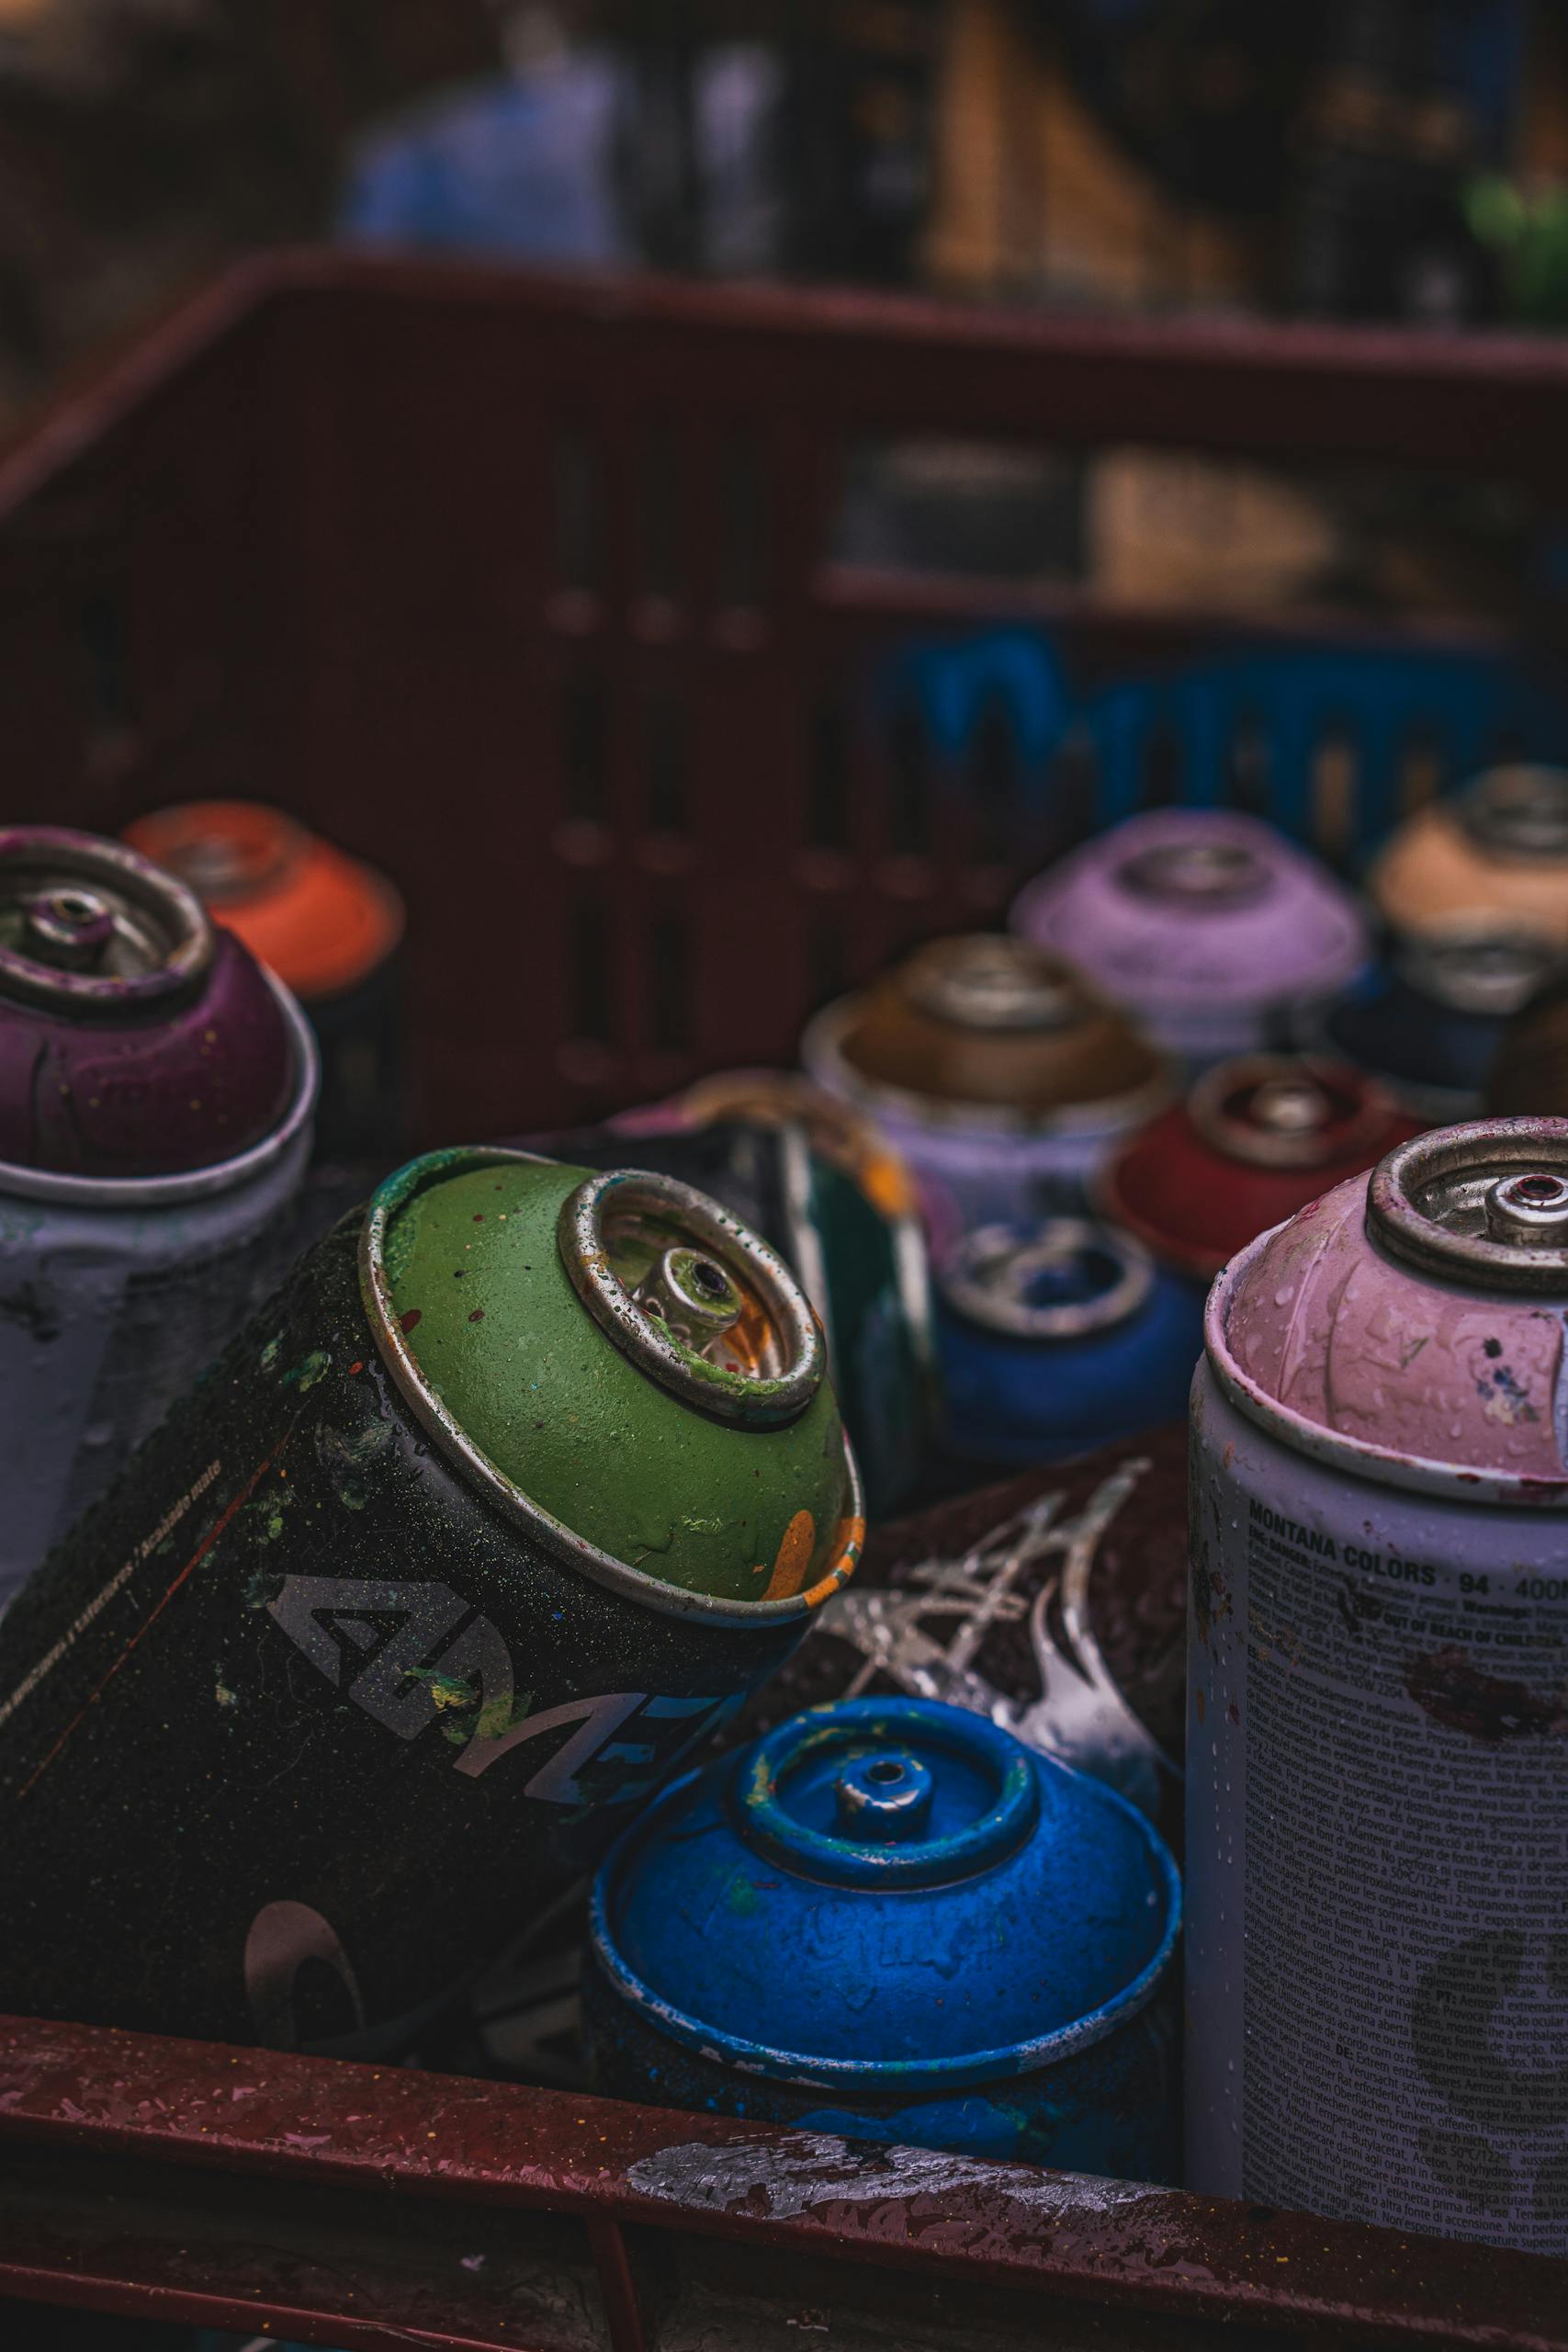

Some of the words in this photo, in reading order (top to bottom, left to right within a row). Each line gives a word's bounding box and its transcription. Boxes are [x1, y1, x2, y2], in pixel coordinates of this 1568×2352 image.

[1249, 1497, 1336, 1560] MONTANA
[1345, 1544, 1435, 1588] COLORS
[1459, 1571, 1488, 1595] 94
[1383, 1611, 1407, 1630] OUT
[1411, 1619, 1427, 1634] OF
[1430, 1623, 1472, 1642] REACH
[1475, 1630, 1490, 1644] OF
[1332, 1734, 1374, 1758] cualquier
[1376, 1749, 1396, 1764] otra
[1398, 1752, 1431, 1772] fuente
[1339, 1723, 1371, 1743] envase
[1440, 1747, 1492, 1767] Mantener
[1360, 1715, 1389, 1734] ocular
[1426, 1730, 1468, 1749] Provoca
[1334, 1748, 1378, 1774] exteriores
[1424, 1773, 1450, 1792] lugar
[1453, 1779, 1477, 1794] bien
[1347, 1769, 1408, 1796] conformidad
[1410, 1787, 1429, 1801] con
[1443, 1793, 1497, 1811] normativa
[1303, 1778, 1339, 1804] provocar
[1343, 1792, 1371, 1816] danys
[1342, 1778, 1393, 1806] Importado
[1404, 1797, 1459, 1820] distribuido
[1476, 1811, 1530, 1828] Argentina
[1533, 1818, 1551, 1831] por
[1339, 1805, 1354, 1823] Pot
[1357, 1815, 1398, 1837] provocar
[1402, 1827, 1421, 1842] una
[1425, 1833, 1461, 1849] reacció
[1348, 1823, 1393, 1849] Mantenir
[1394, 1839, 1435, 1860] allunyat
[1451, 1849, 1478, 1866] fonts
[1280, 1821, 1333, 1858] temperatures
[1336, 1849, 1379, 1874] superiors
[1457, 1880, 1500, 1897] Eliminar
[1315, 1824, 1334, 1844] font
[1398, 1855, 1438, 1874] perforar
[1497, 1871, 1517, 1884] fins
[1308, 1865, 1336, 1887] graves
[1339, 1879, 1360, 1896] pour
[1379, 1893, 1418, 1913] organes
[1443, 1907, 1469, 1922] suite
[1334, 1862, 1449, 1905] polihidroxialquilamides
[1293, 1885, 1319, 1908] portée
[1321, 1896, 1337, 1916] des
[1338, 1906, 1376, 1929] enfants.
[1380, 1918, 1397, 1936] Lire
[1329, 1889, 1375, 1916] provoquer
[1378, 1906, 1438, 1931] somnolence
[1300, 1917, 1330, 1940] endroit
[1334, 1930, 1353, 1950] bien
[1416, 1959, 1433, 1973] pas
[1437, 1963, 1477, 1980] respirer
[1481, 1968, 1495, 1982] les
[1313, 1938, 1379, 1973] conformément
[1416, 1972, 1496, 1996] réglementation
[1505, 1984, 1539, 1998] locale.
[1382, 1936, 1399, 1951] pas
[1402, 1941, 1448, 1961] vaporiser
[1450, 1951, 1466, 1964] sur
[1470, 1954, 1489, 1967] une
[1492, 1955, 1534, 1970] flamme
[1278, 1946, 1323, 1980] prolongada
[1337, 1976, 1375, 1999] repetida
[1378, 1991, 1393, 2006] por
[1443, 2004, 1484, 2022] Provoca
[1486, 2010, 1529, 2029] irritação
[1295, 1970, 1337, 2000] necessário
[1340, 1991, 1383, 2016] consultar
[1404, 2011, 1443, 2032] médico,
[1446, 2021, 1505, 2039] mostre-lhe
[1437, 1988, 1456, 2005] PT:
[1460, 1993, 1503, 2010] Aerossol
[1306, 2004, 1336, 2027] apenas
[1361, 2024, 1382, 2043] livre
[1416, 2040, 1444, 2058] locais
[1446, 2046, 1470, 2063] bem
[1344, 2006, 1375, 2027] chama
[1378, 2018, 1409, 2037] aberta
[1420, 2030, 1452, 2046] outras
[1454, 2034, 1486, 2051] fontes
[1336, 2041, 1353, 2061] DE:
[1356, 2050, 1390, 2073] Extrem
[1393, 2064, 1461, 2089] entzündbares
[1510, 2082, 1553, 2097] Behälter
[1337, 2031, 1369, 2052] acordo
[1371, 2043, 1391, 2060] com
[1406, 2054, 1477, 2077] regulamentos
[1514, 2069, 1555, 2083] Contém
[1348, 2061, 1398, 2089] Verursacht
[1402, 2081, 1444, 2100] schwere
[1293, 2075, 1349, 2115] durchstechen
[1351, 2105, 1372, 2123] oder
[1435, 2130, 1461, 2144] auch
[1462, 2133, 1489, 2148] nicht
[1492, 2138, 1517, 2151] nach
[1303, 2067, 1332, 2094] heißen
[1396, 2104, 1435, 2128] Funken,
[1437, 2115, 1477, 2133] offenen
[1481, 2121, 1530, 2138] Flammen
[1534, 2126, 1565, 2138] sowie
[1337, 2070, 1352, 2088] Rat
[1354, 2079, 1411, 2109] erforderlich,
[1415, 2095, 1474, 2122] Verpackung
[1477, 2108, 1501, 2121] oder
[1292, 2091, 1311, 2111] nicht
[1314, 2100, 1377, 2138] Temperaturen
[1380, 2129, 1398, 2144] von
[1402, 2135, 1428, 2152] mehr
[1432, 2142, 1447, 2155] als
[1294, 2120, 1334, 2149] provocare
[1336, 2138, 1361, 2160] danni
[1364, 2151, 1382, 2168] agli
[1384, 2158, 1416, 2177] organi
[1469, 2177, 1529, 2192] esposizione
[1342, 2156, 1388, 2183] provocare
[1390, 2174, 1409, 2188] una
[1411, 2179, 1454, 2198] reazione
[1456, 2187, 1499, 2206] allergica
[1413, 2150, 1451, 2172] Aceton,
[1308, 2165, 1342, 2193] fiamma
[1380, 2197, 1402, 2213] altra
[1404, 2201, 1431, 2221] fonte
[1507, 2220, 1529, 2233] Non
[1326, 2190, 1350, 2212] raggi
[1382, 2209, 1402, 2227] Non
[1404, 2218, 1442, 2236] esporre
[1339, 2166, 1377, 2192] Leggere
[1432, 2197, 1462, 2213] prima
[1515, 2207, 1550, 2221] Tenere
